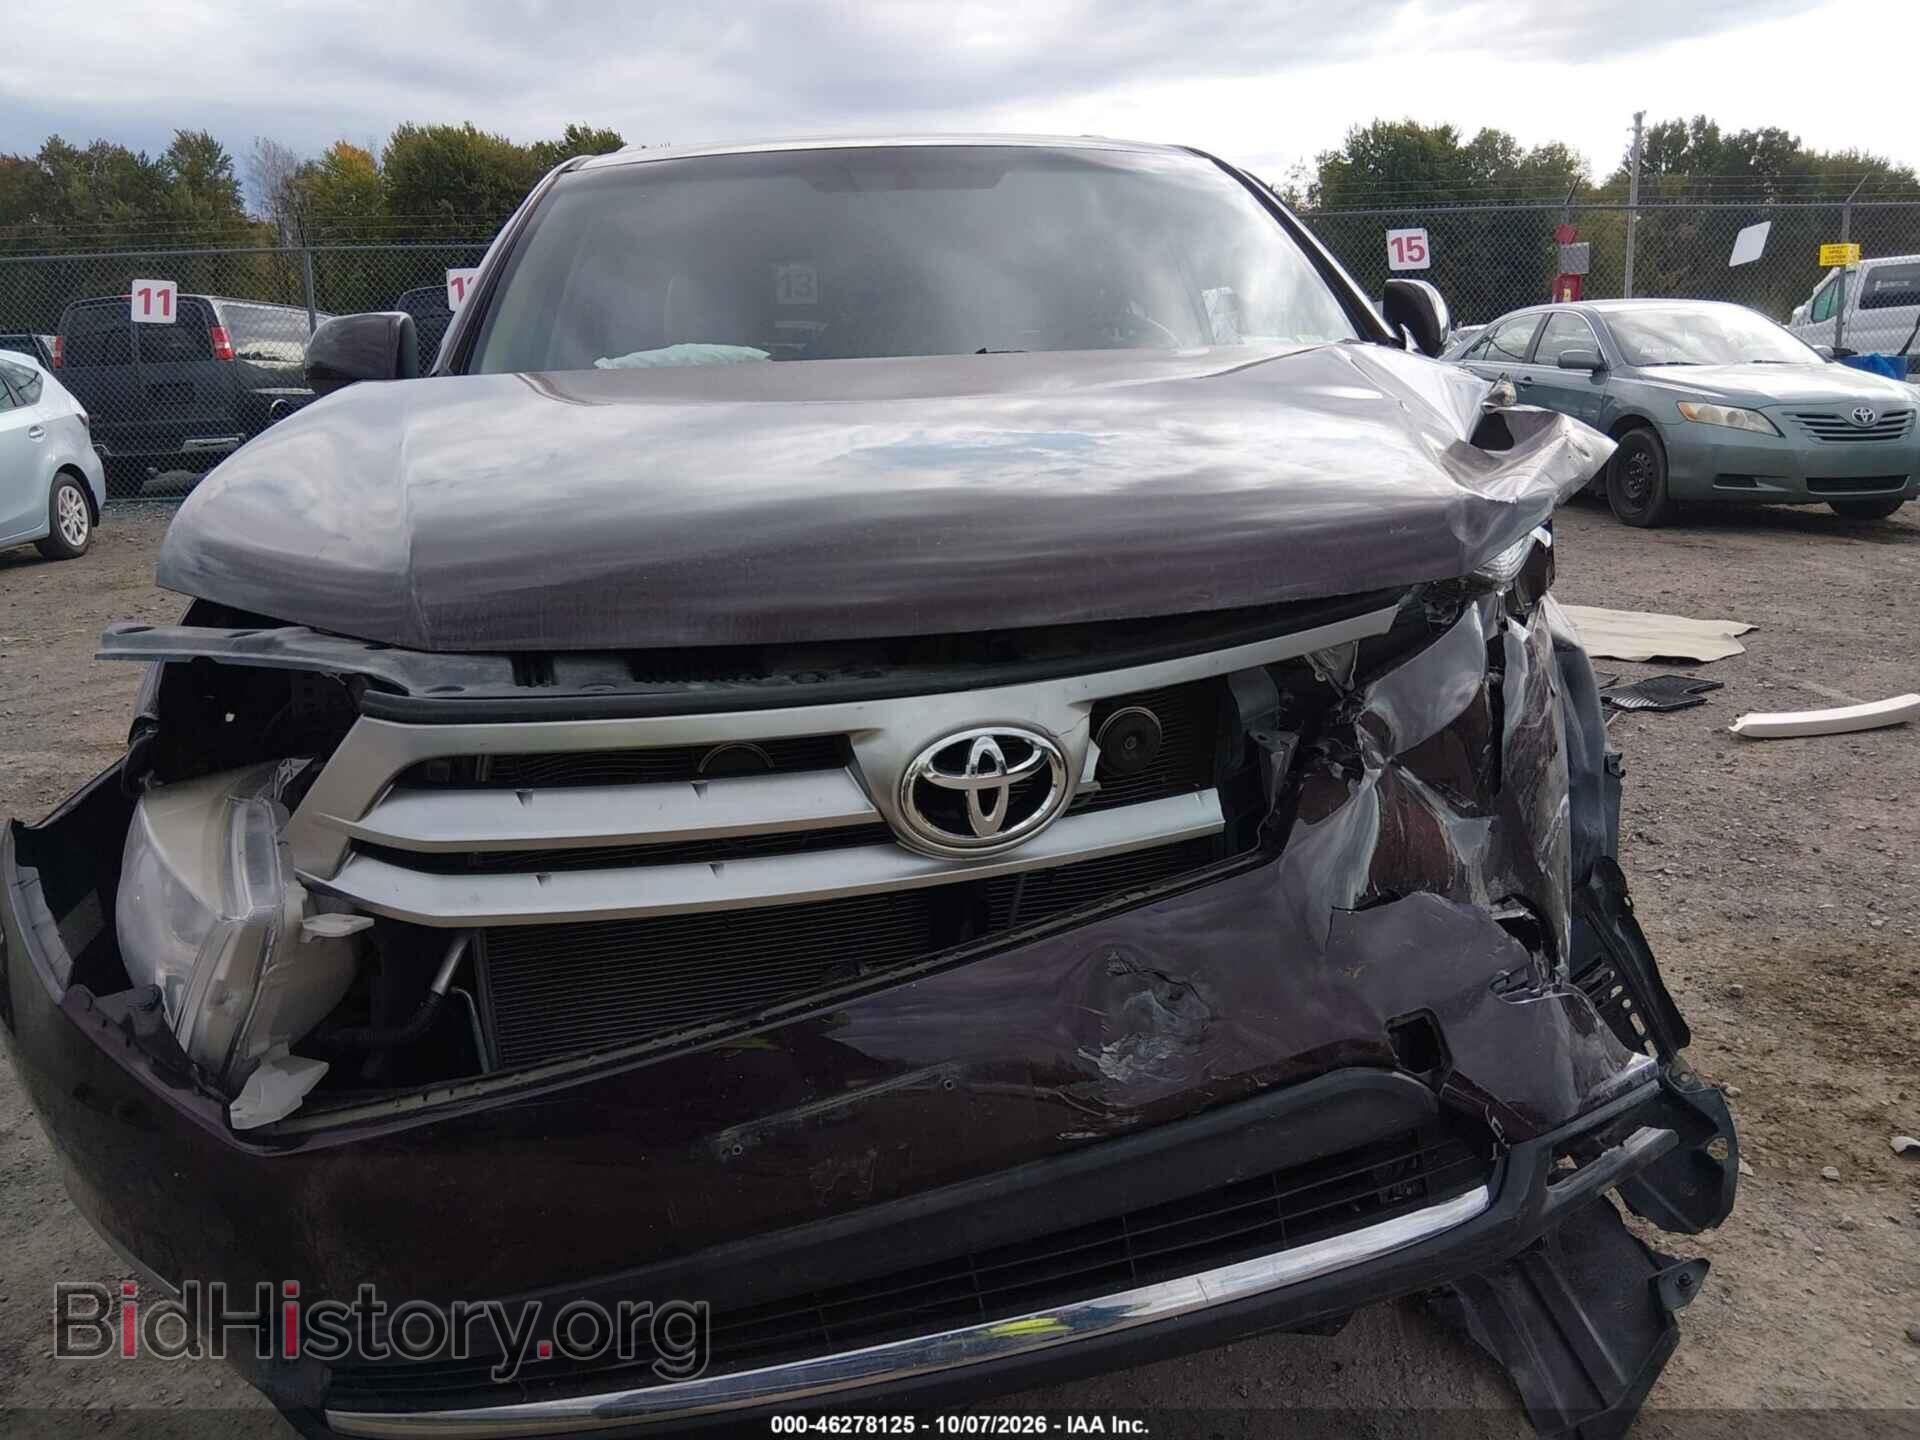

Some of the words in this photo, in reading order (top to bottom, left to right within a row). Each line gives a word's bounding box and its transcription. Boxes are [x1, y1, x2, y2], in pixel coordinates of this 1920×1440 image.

[1391, 236, 1425, 263] 15
[450, 276, 478, 304] 1
[781, 273, 812, 298] 13
[137, 288, 170, 316] 11
